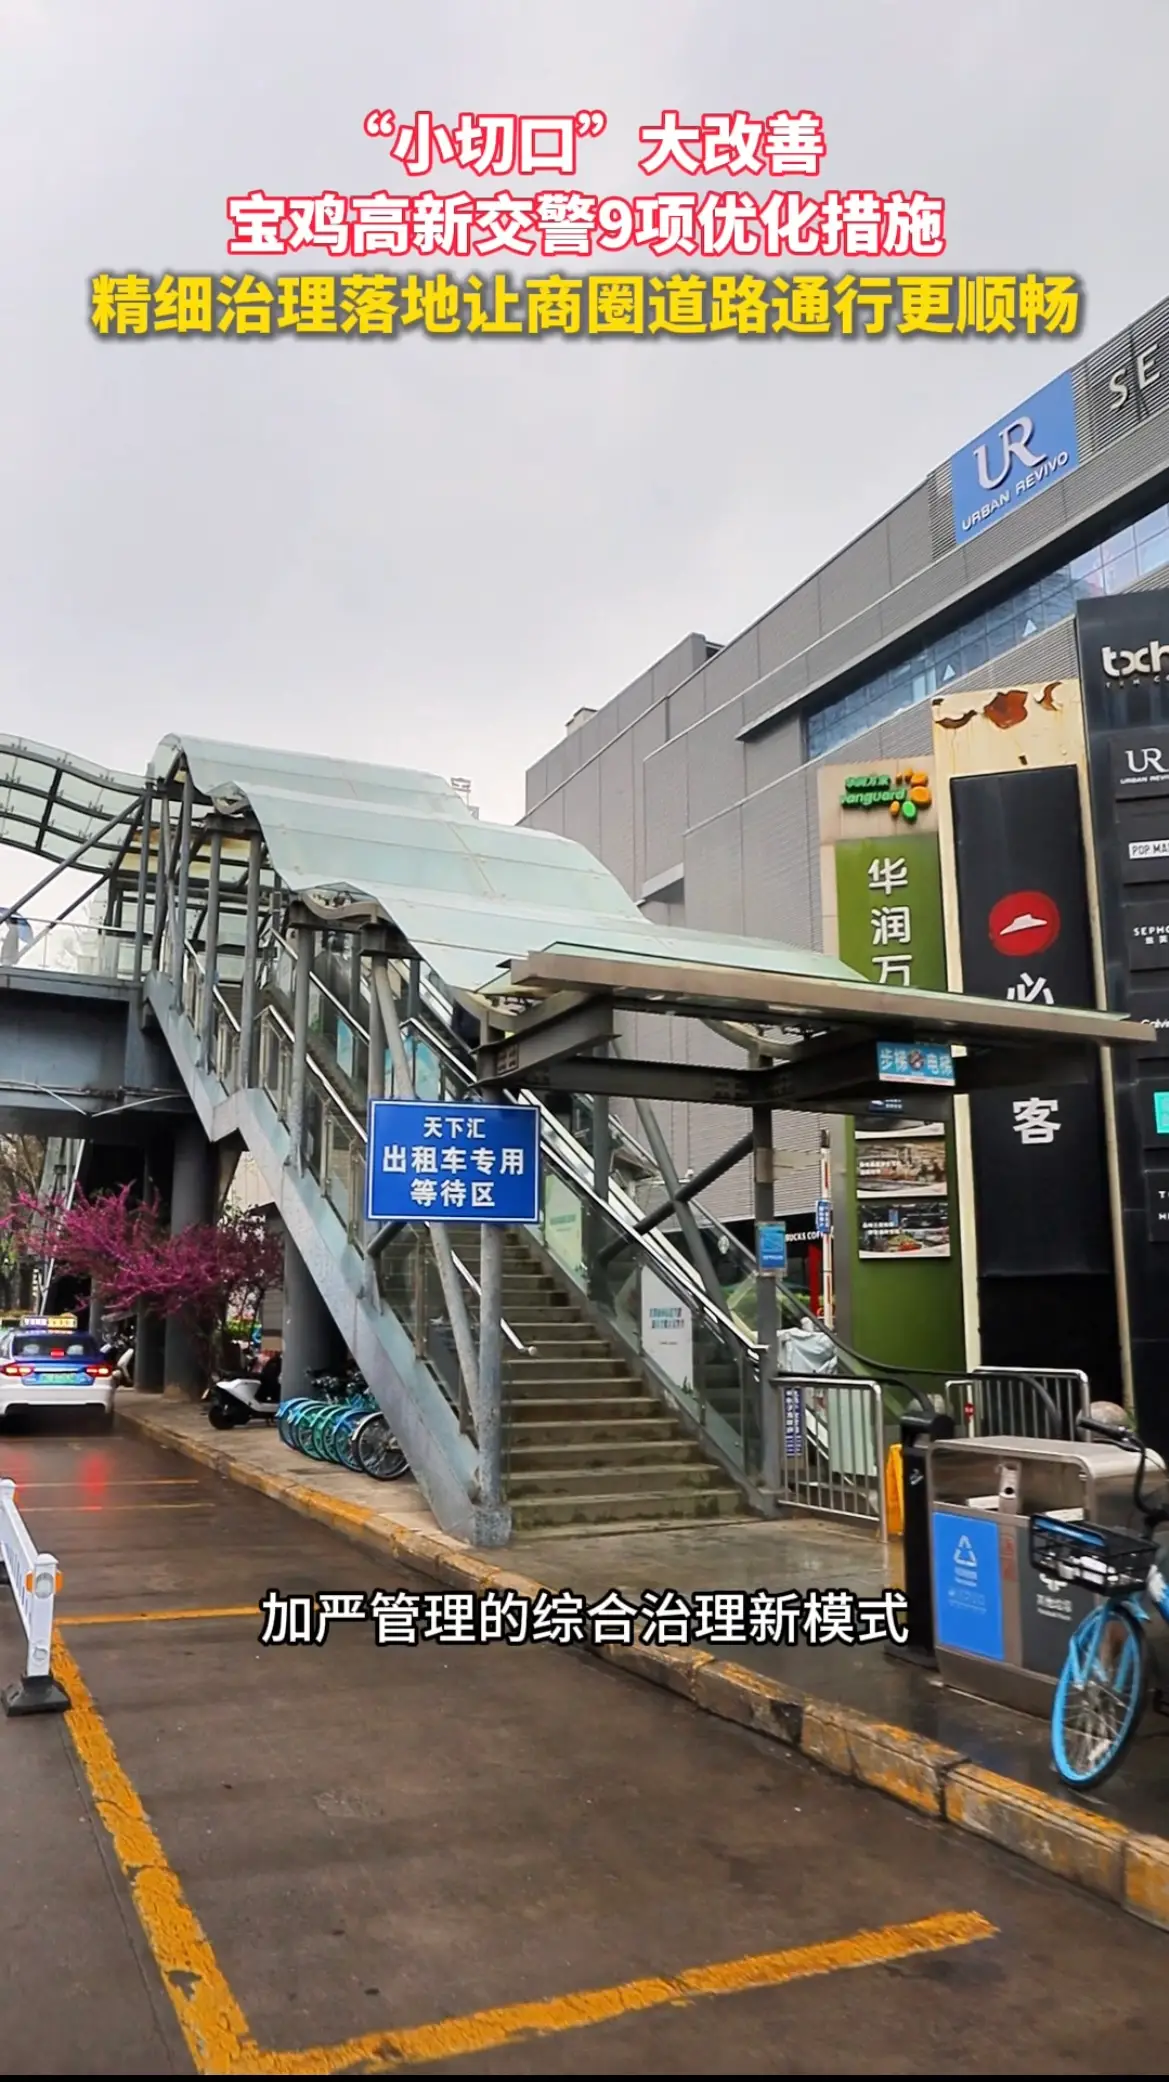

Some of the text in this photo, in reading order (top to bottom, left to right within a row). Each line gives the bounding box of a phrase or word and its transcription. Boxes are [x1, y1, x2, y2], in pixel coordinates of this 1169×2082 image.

[973, 416, 1048, 491] UR
[961, 450, 1070, 532] URBAN REVIVO
[1125, 747, 1169, 773] UR
[1131, 844, 1150, 857] POP
[423, 1116, 486, 1139] 天下汇
[383, 1145, 525, 1175] 出租车专用
[410, 1178, 496, 1208] 等待区
